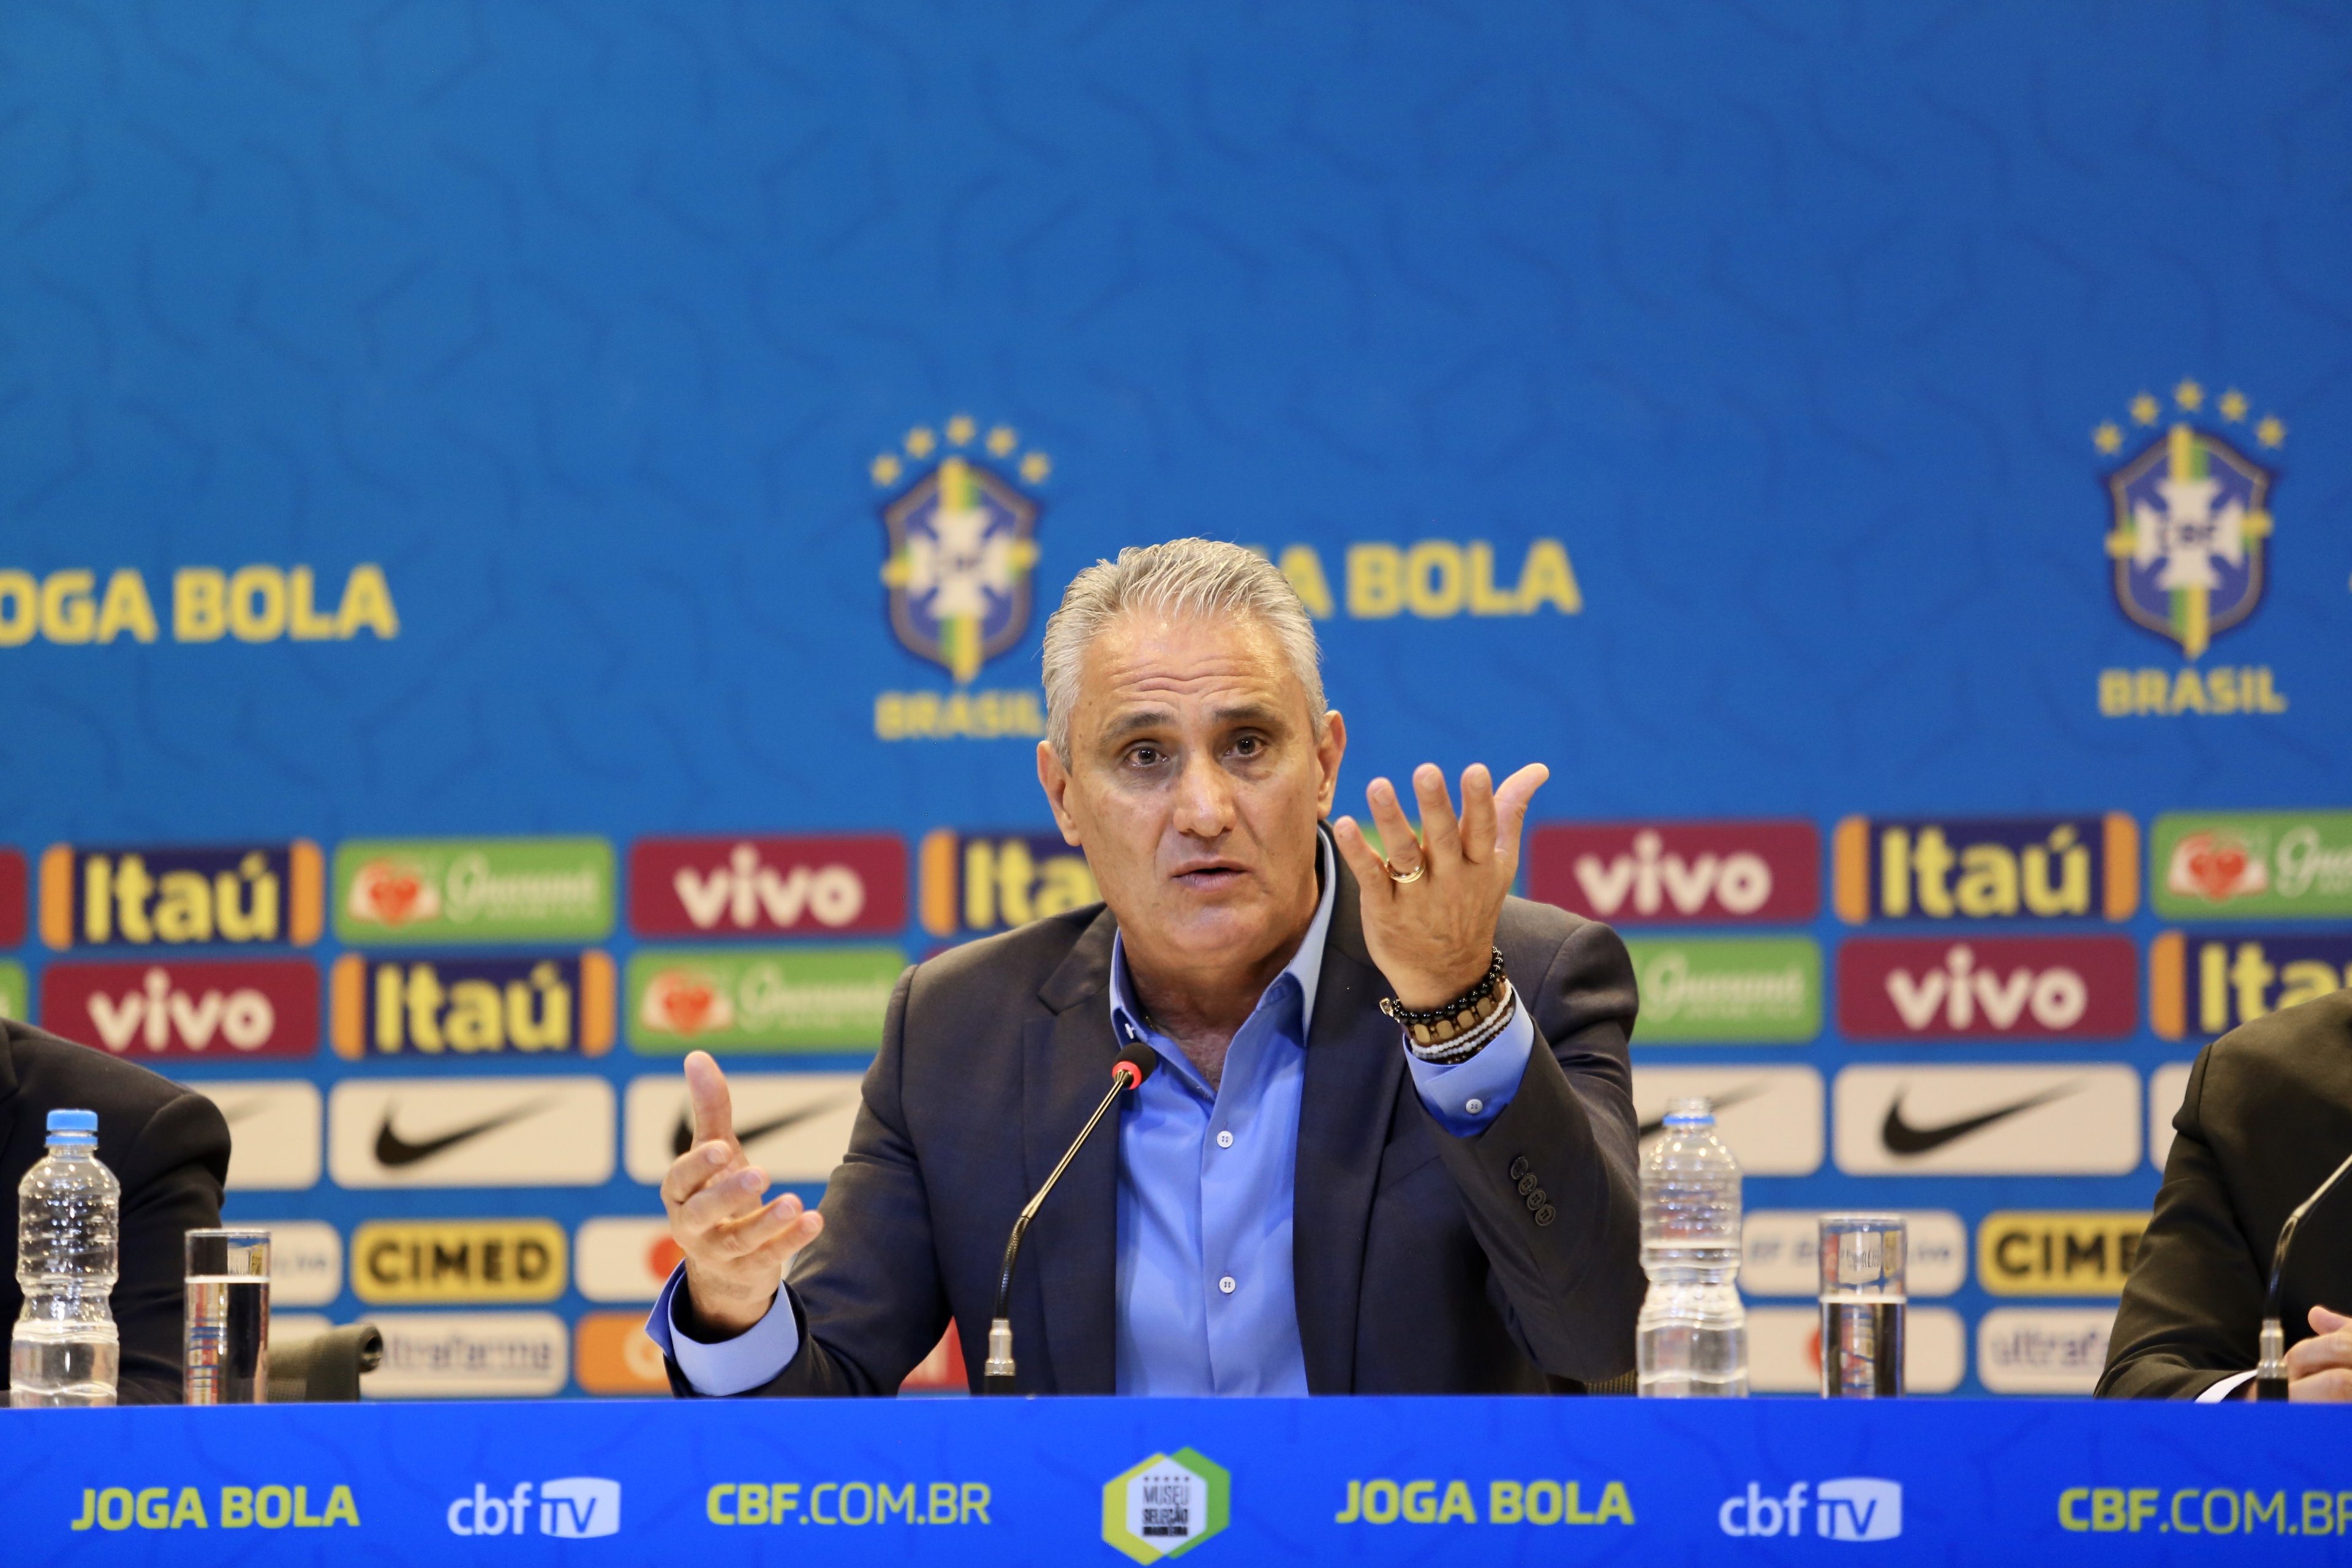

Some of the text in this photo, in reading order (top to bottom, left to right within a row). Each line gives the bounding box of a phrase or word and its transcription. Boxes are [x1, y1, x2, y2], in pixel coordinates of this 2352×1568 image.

[0, 564, 399, 647] OGA BOLA
[1346, 539, 1582, 619] BOLA
[874, 691, 1046, 739] BRASIL
[2099, 666, 2286, 717] BRASIL
[85, 852, 279, 944] Itaú
[675, 844, 864, 928] vivo
[965, 839, 1101, 929] Ita
[1575, 830, 1772, 915] vivo
[1882, 825, 2090, 918] Itaú
[88, 968, 274, 1051] vivo
[375, 960, 572, 1053] Itaú
[1887, 946, 2087, 1029] vivo
[2200, 943, 2352, 1033] Ita
[368, 1238, 551, 1285] CIMED
[1994, 1231, 2145, 1278] CIME
[71, 1484, 360, 1531] JOGA BOLA
[447, 1481, 533, 1536] cbf
[706, 1482, 991, 1526] CBF.COM.BR
[1335, 1479, 1635, 1526] JOGA BOLA
[1719, 1481, 1809, 1537] cbf
